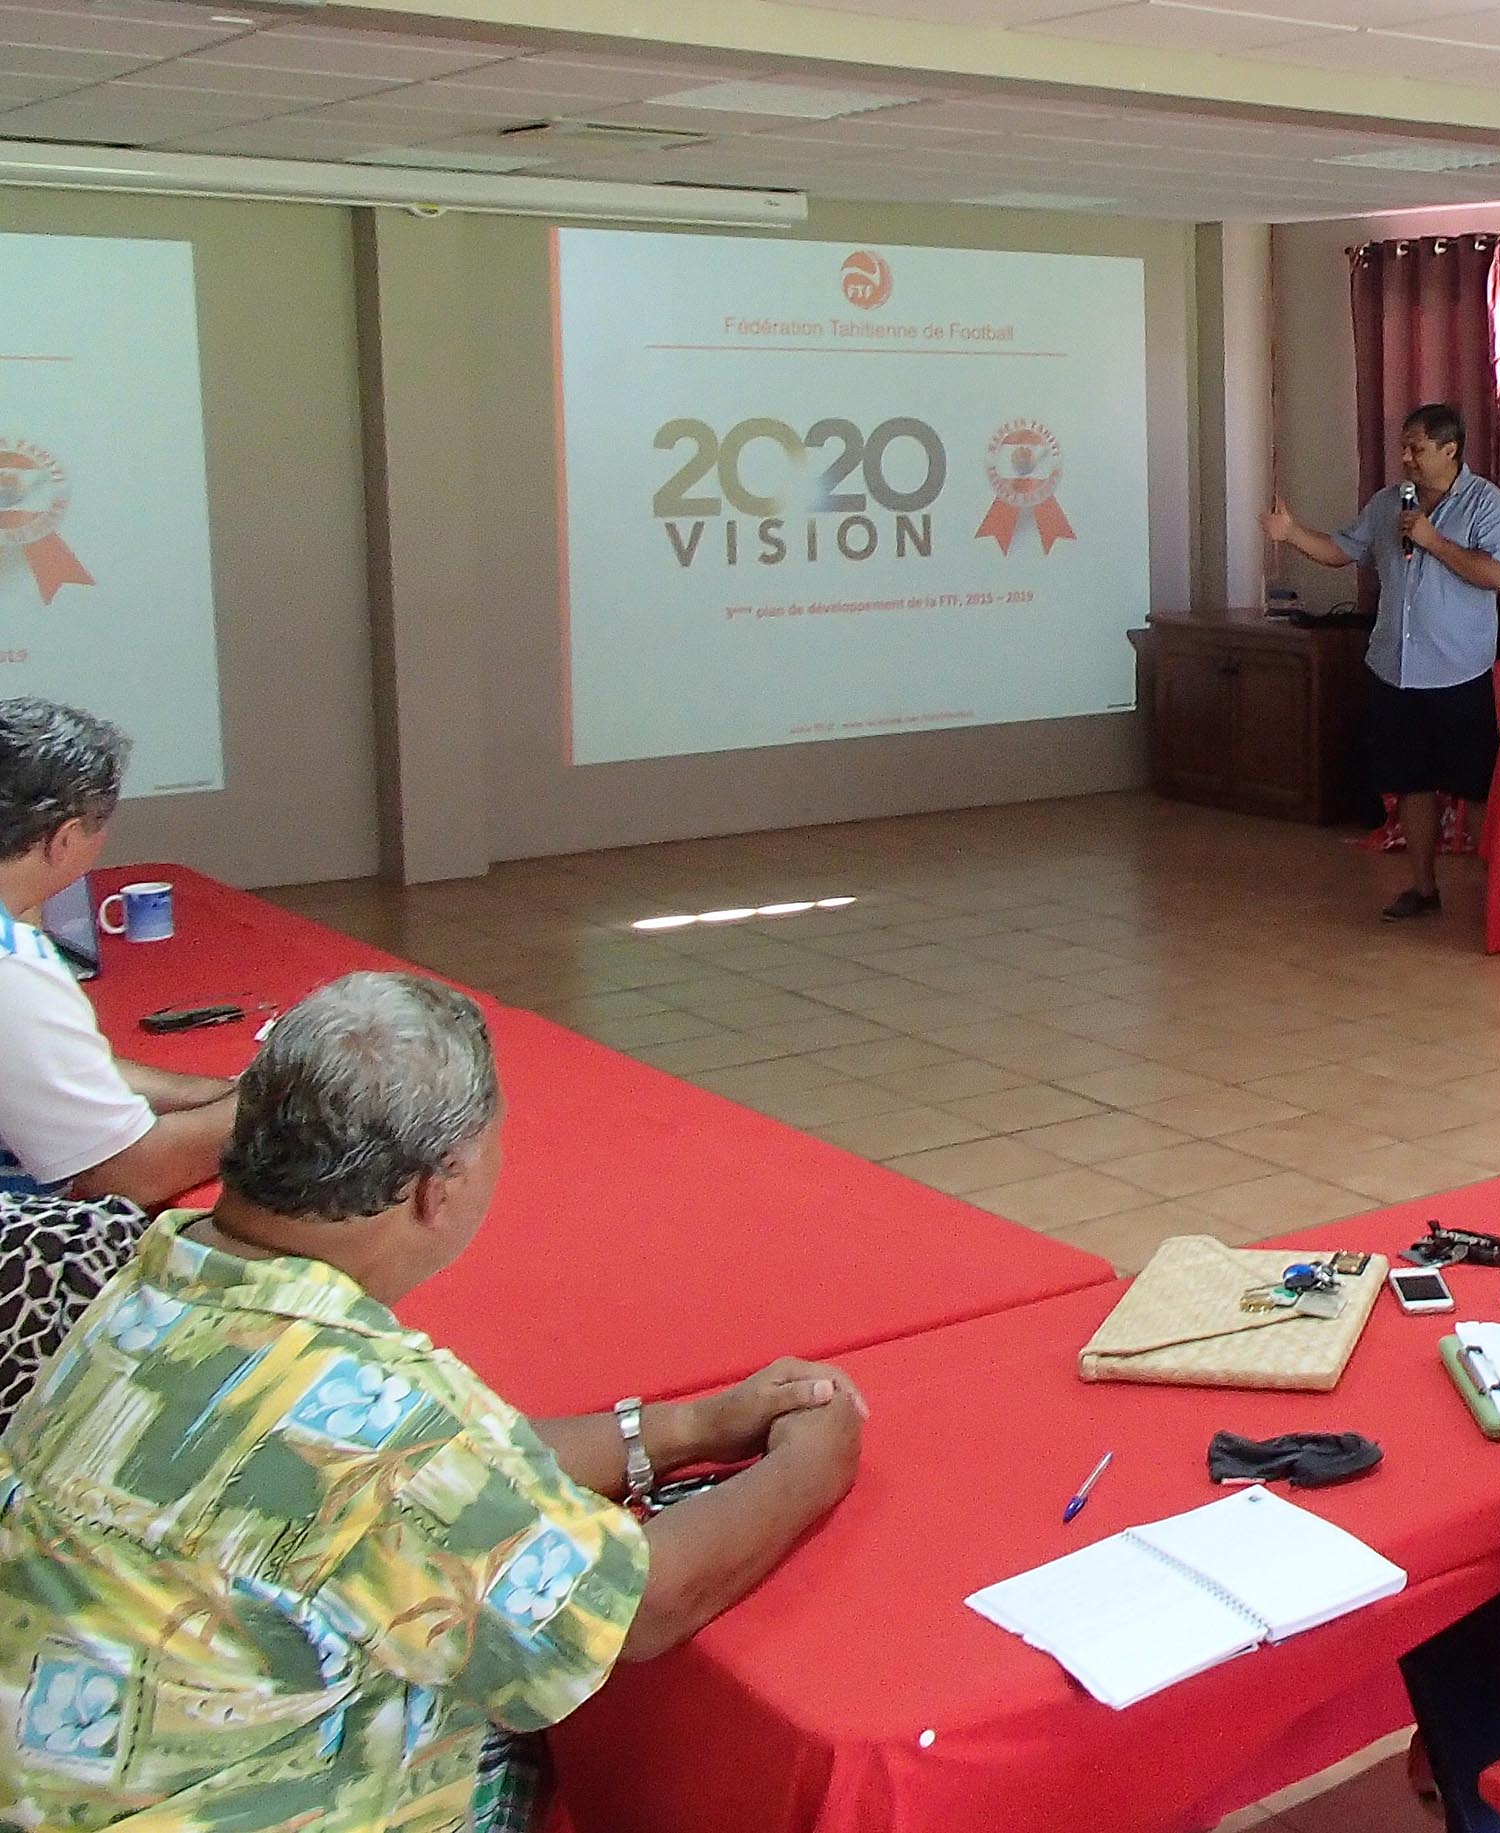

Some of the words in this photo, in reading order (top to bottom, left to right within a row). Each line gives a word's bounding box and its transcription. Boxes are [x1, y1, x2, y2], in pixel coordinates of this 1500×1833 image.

[724, 316, 823, 336] Fédération
[830, 319, 918, 339] Tahitienne
[922, 321, 945, 340] de
[950, 322, 1014, 341] Football
[653, 416, 947, 518] 2020
[664, 514, 932, 567] VISION
